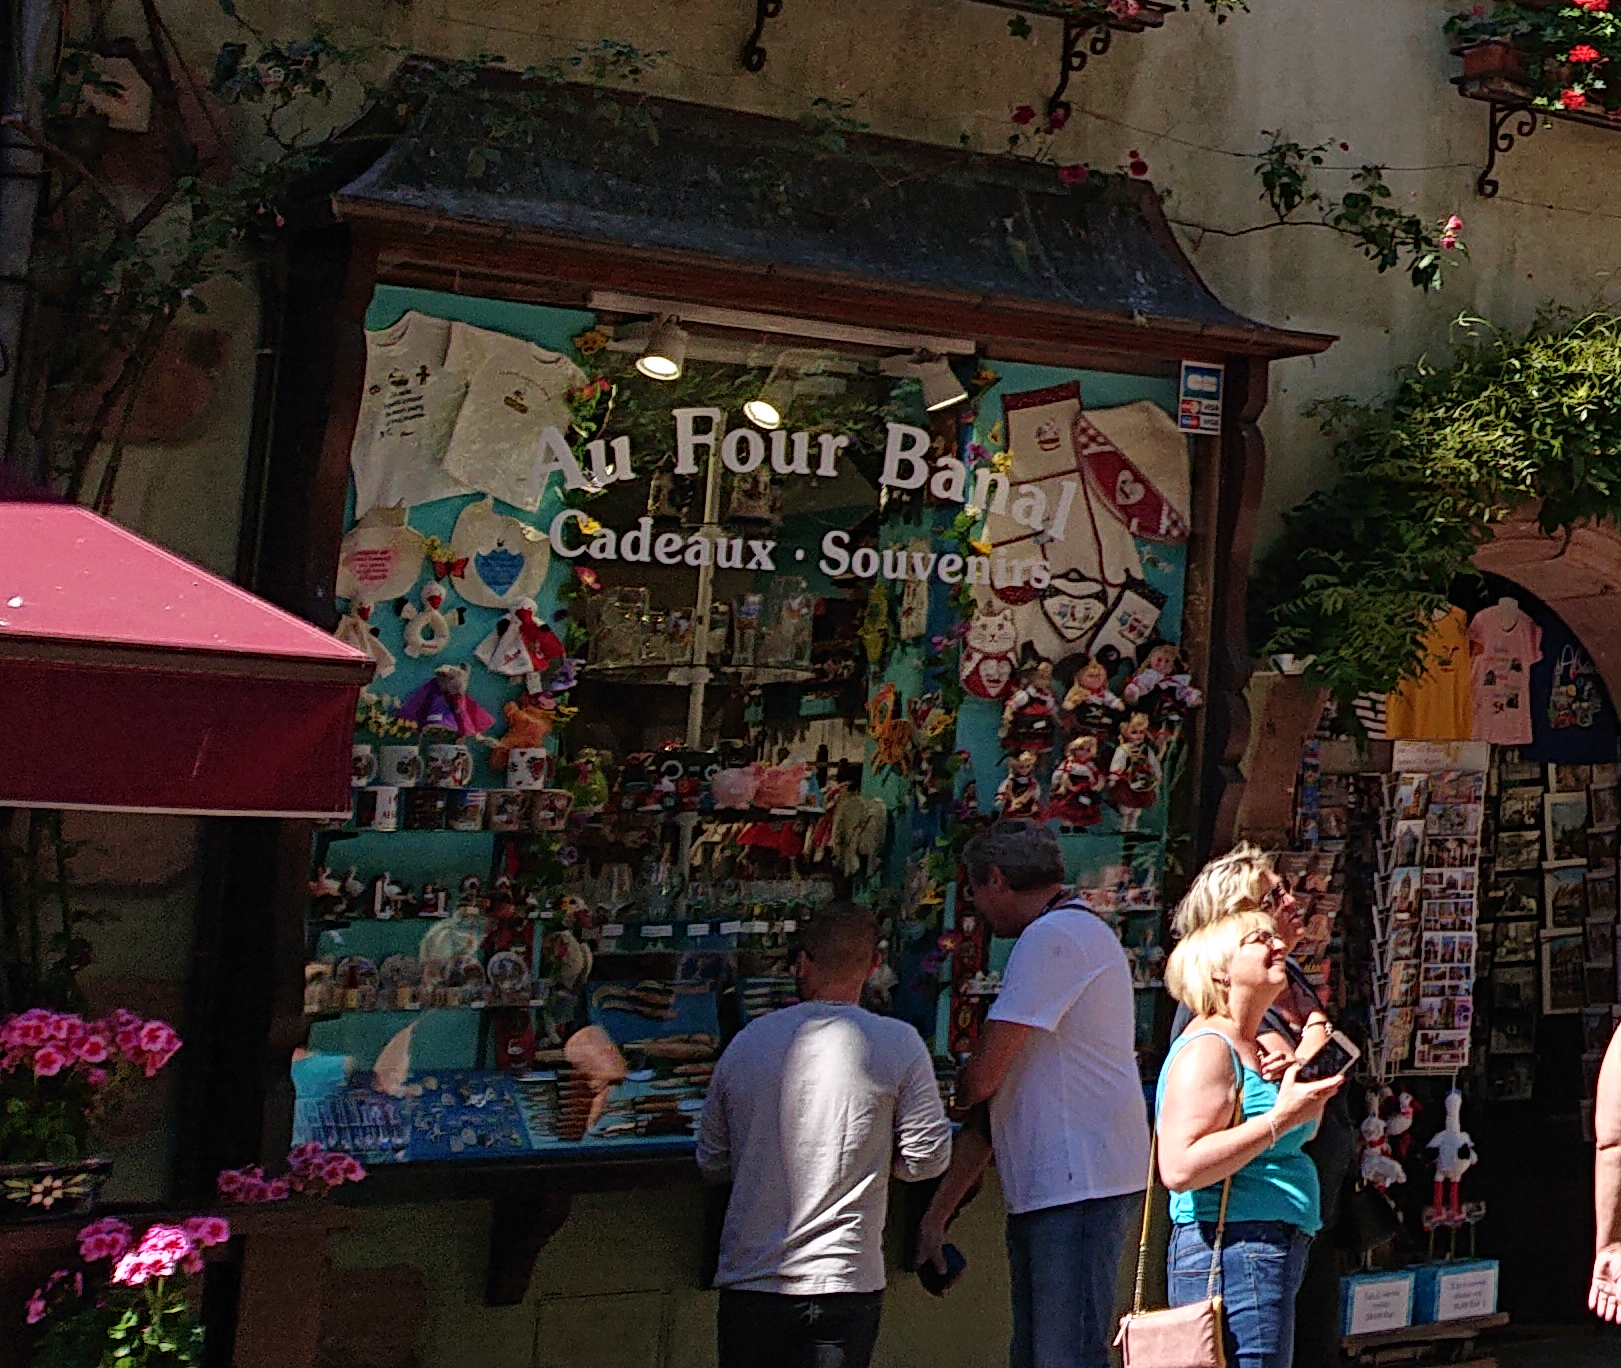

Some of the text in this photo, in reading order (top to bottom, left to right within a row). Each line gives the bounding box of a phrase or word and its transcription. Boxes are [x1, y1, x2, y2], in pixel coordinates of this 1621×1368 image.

[530, 406, 1080, 543] Au Four Banal
[549, 508, 775, 573] Cadeaux
[819, 530, 1050, 591] Souvenirs
